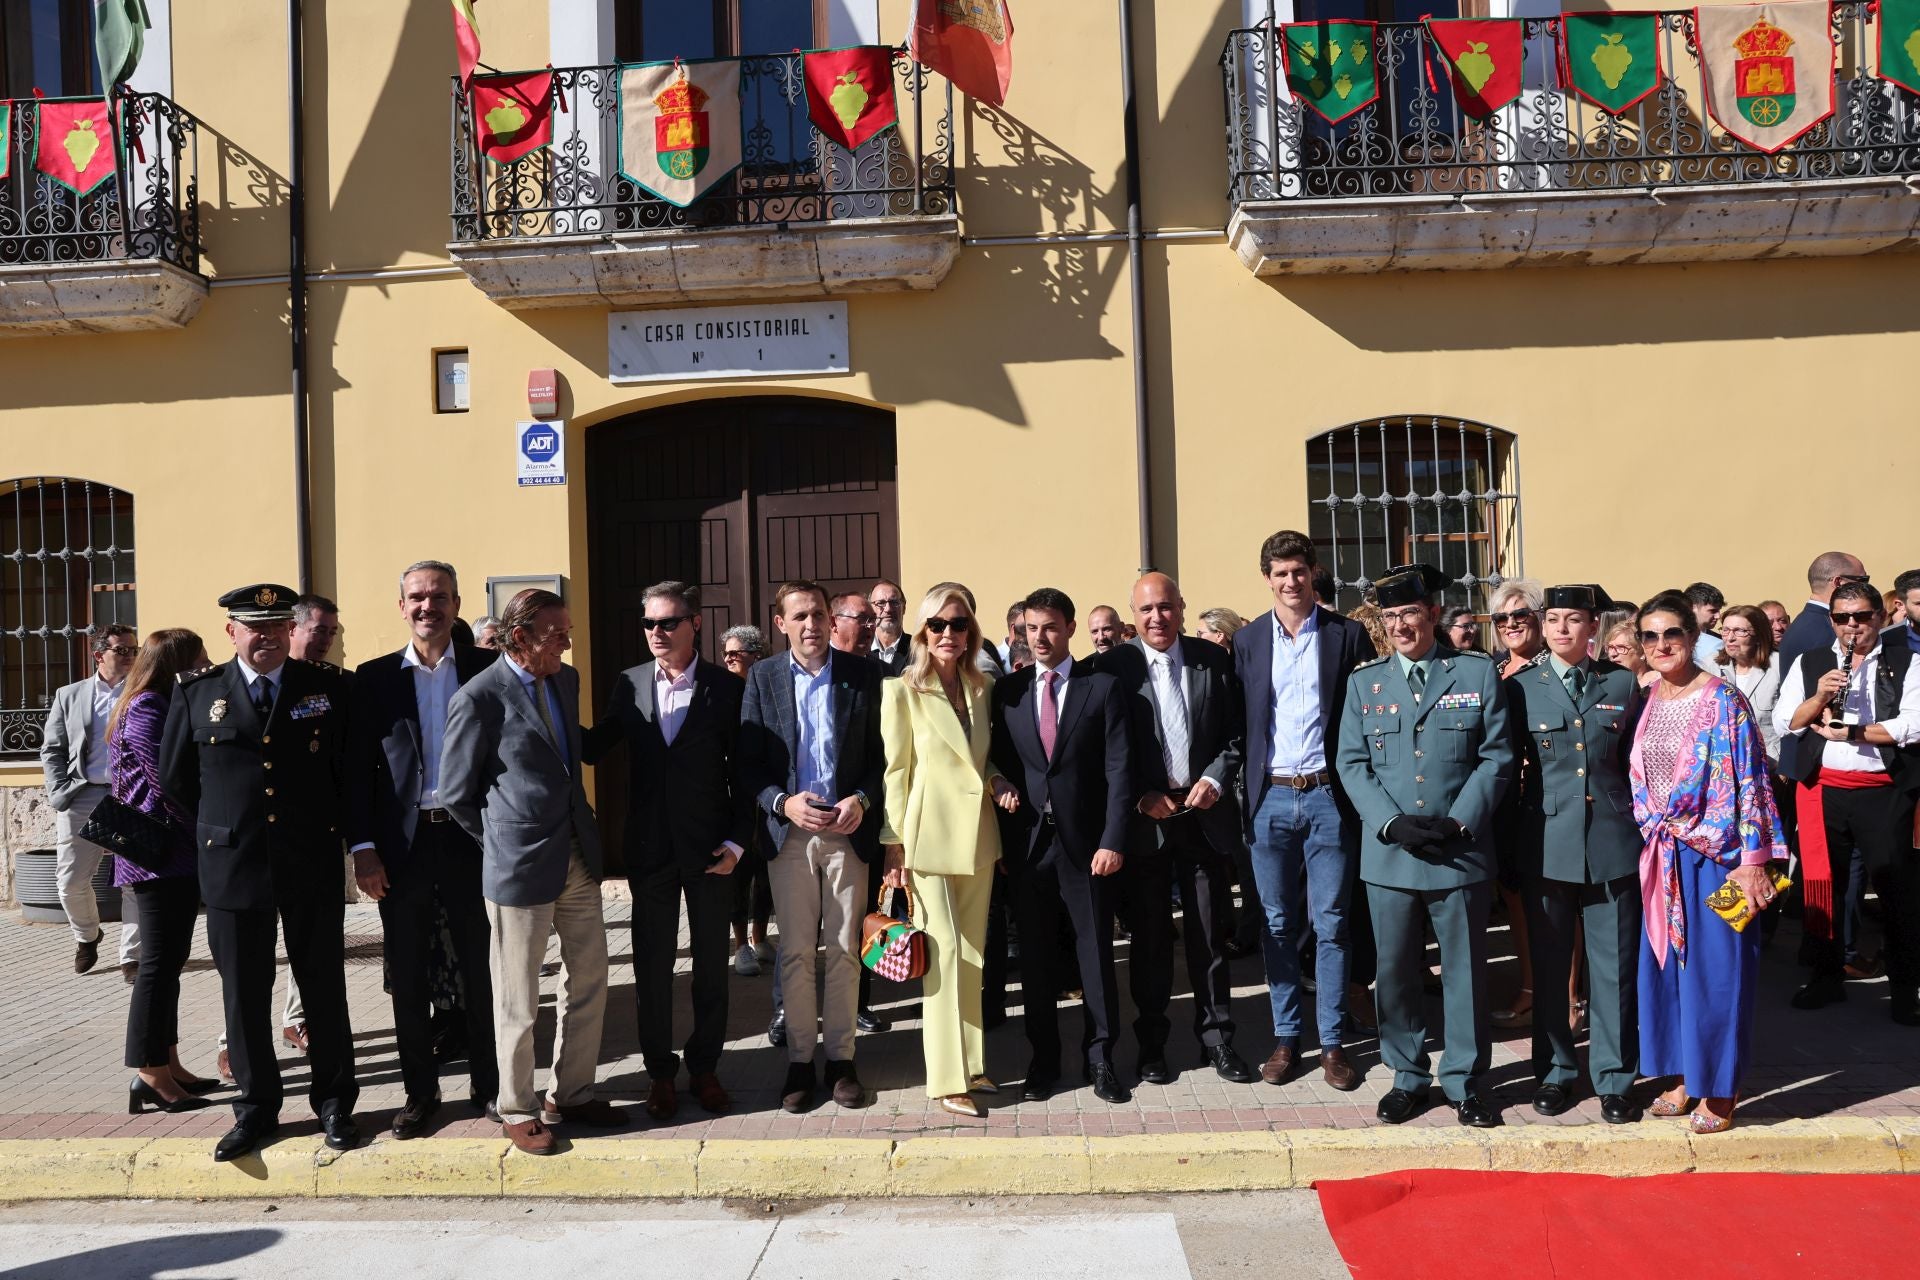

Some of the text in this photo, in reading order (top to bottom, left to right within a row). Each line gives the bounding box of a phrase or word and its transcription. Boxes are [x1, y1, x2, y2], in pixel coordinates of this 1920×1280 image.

[645, 318, 810, 342] CASA CONSISTORIAL
[758, 348, 763, 361] 1
[528, 437, 553, 450] ADT
